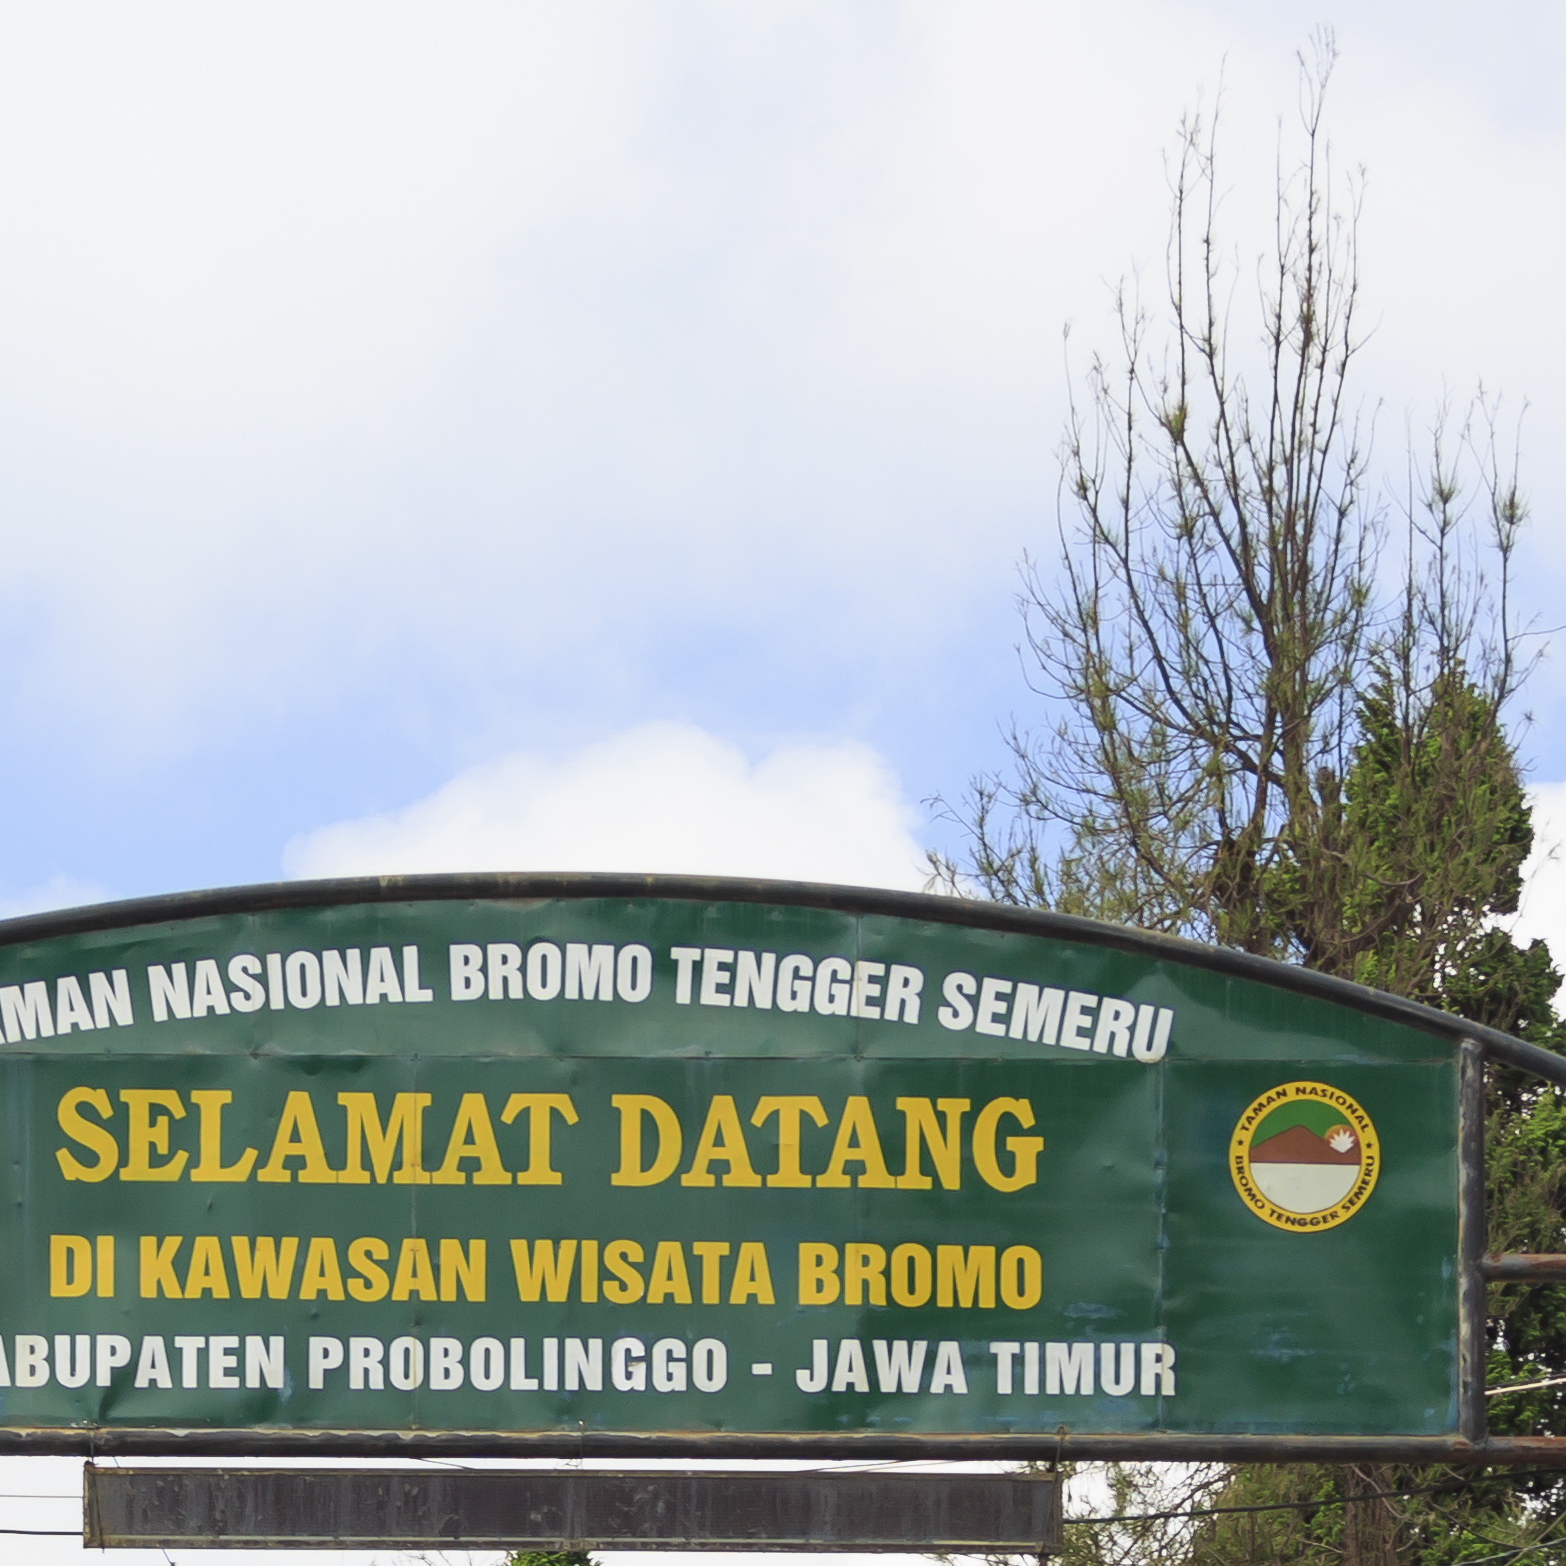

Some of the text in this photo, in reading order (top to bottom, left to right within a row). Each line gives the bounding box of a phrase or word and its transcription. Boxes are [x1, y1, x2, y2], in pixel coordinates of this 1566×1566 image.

[147, 944, 435, 1025] NASIONAL
[448, 941, 653, 1004] BROMO
[669, 945, 925, 1026] TENGGER
[936, 970, 1175, 1064] SEMERU
[54, 1085, 1045, 1194] SELAMAT DATANG
[1240, 1085, 1370, 1134] TAMAN NASIONAL
[1234, 1154, 1376, 1228] BROMO TENGGER SEMERU
[48, 1233, 1043, 1311] DI KAWASAN WISATA BROMO
[307, 1335, 729, 1394] PROBOLINGGO
[794, 1338, 969, 1395] JAWA
[988, 1340, 1177, 1398] TIMUR
